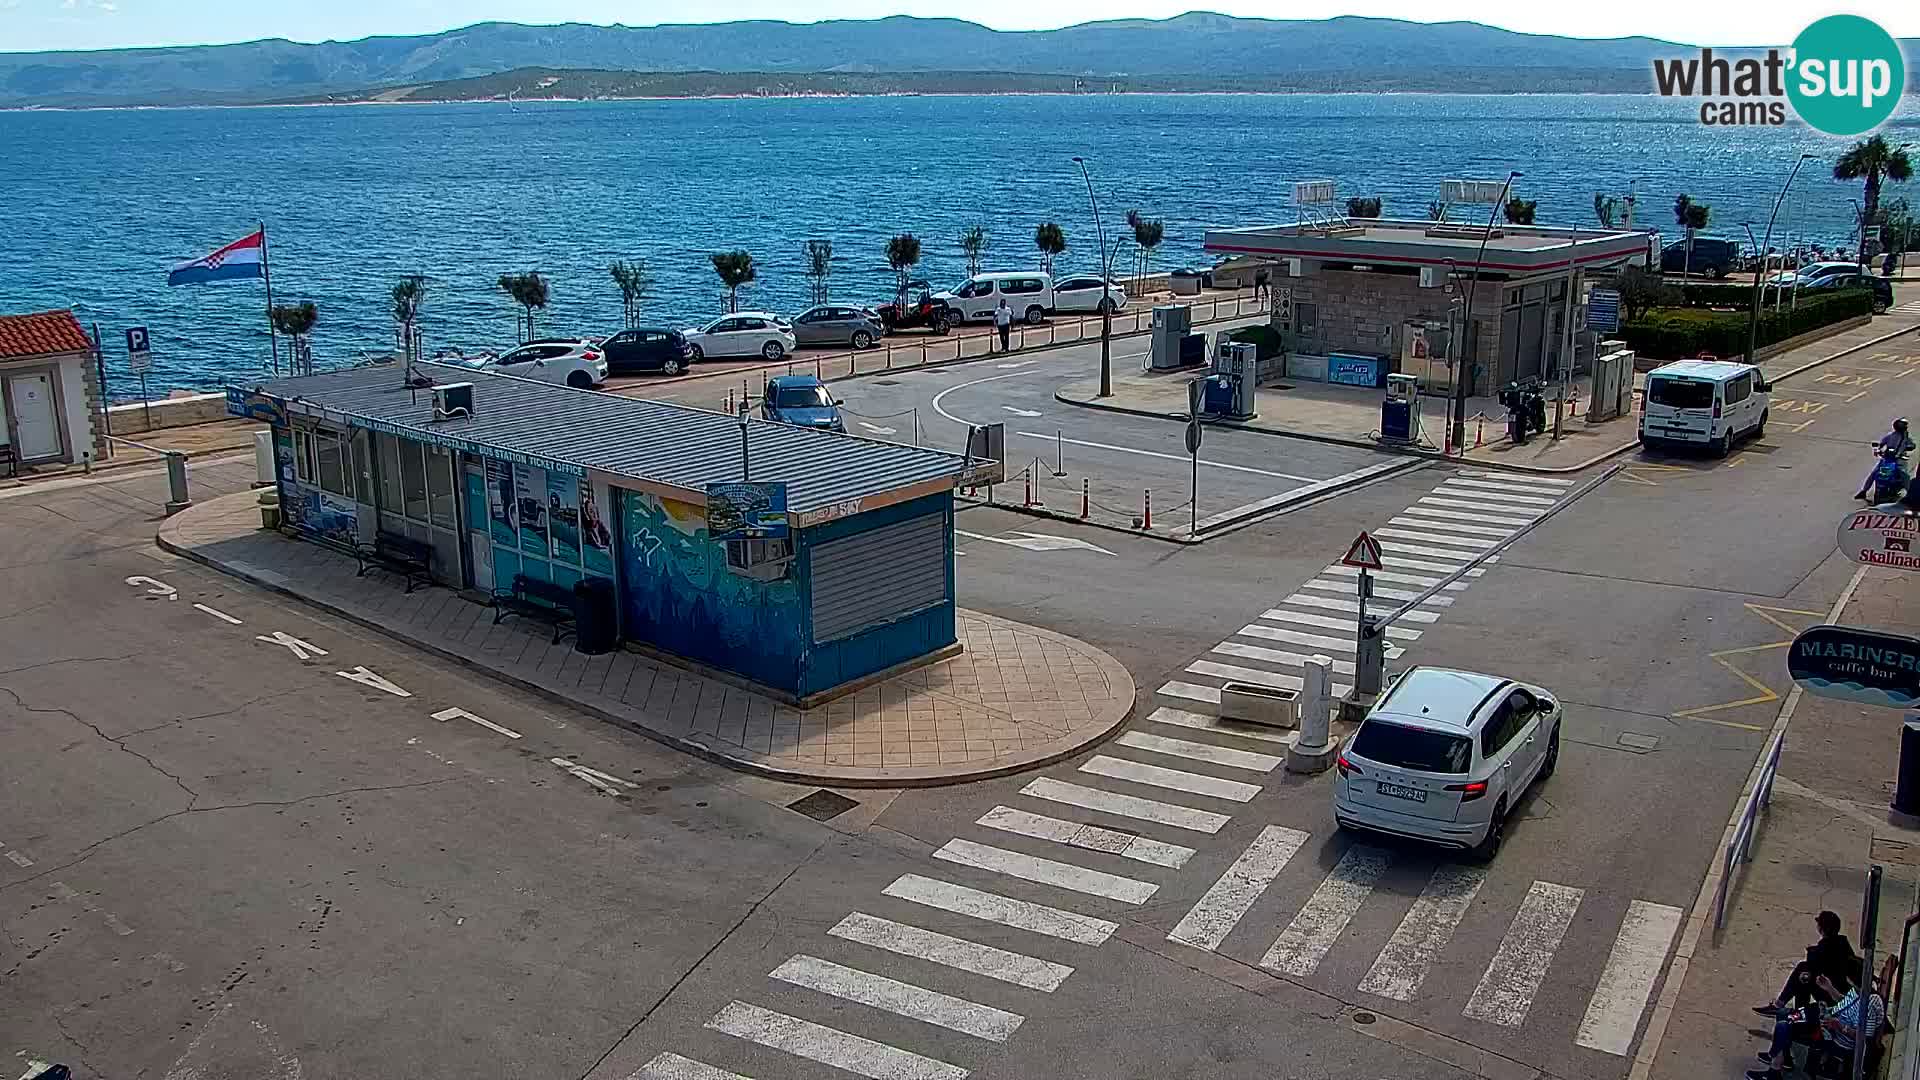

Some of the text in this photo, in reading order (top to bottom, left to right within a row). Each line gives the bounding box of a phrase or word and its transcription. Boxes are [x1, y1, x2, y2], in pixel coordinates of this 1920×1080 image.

[131, 330, 144, 349] P
[437, 437, 468, 451] POSTAJA
[480, 445, 494, 456] BUS
[496, 449, 527, 464] STATION
[529, 456, 554, 470] TICKET
[556, 463, 583, 476] OFFICE
[1848, 514, 1920, 533] PIZZE
[1828, 662, 1896, 679] caffe bar
